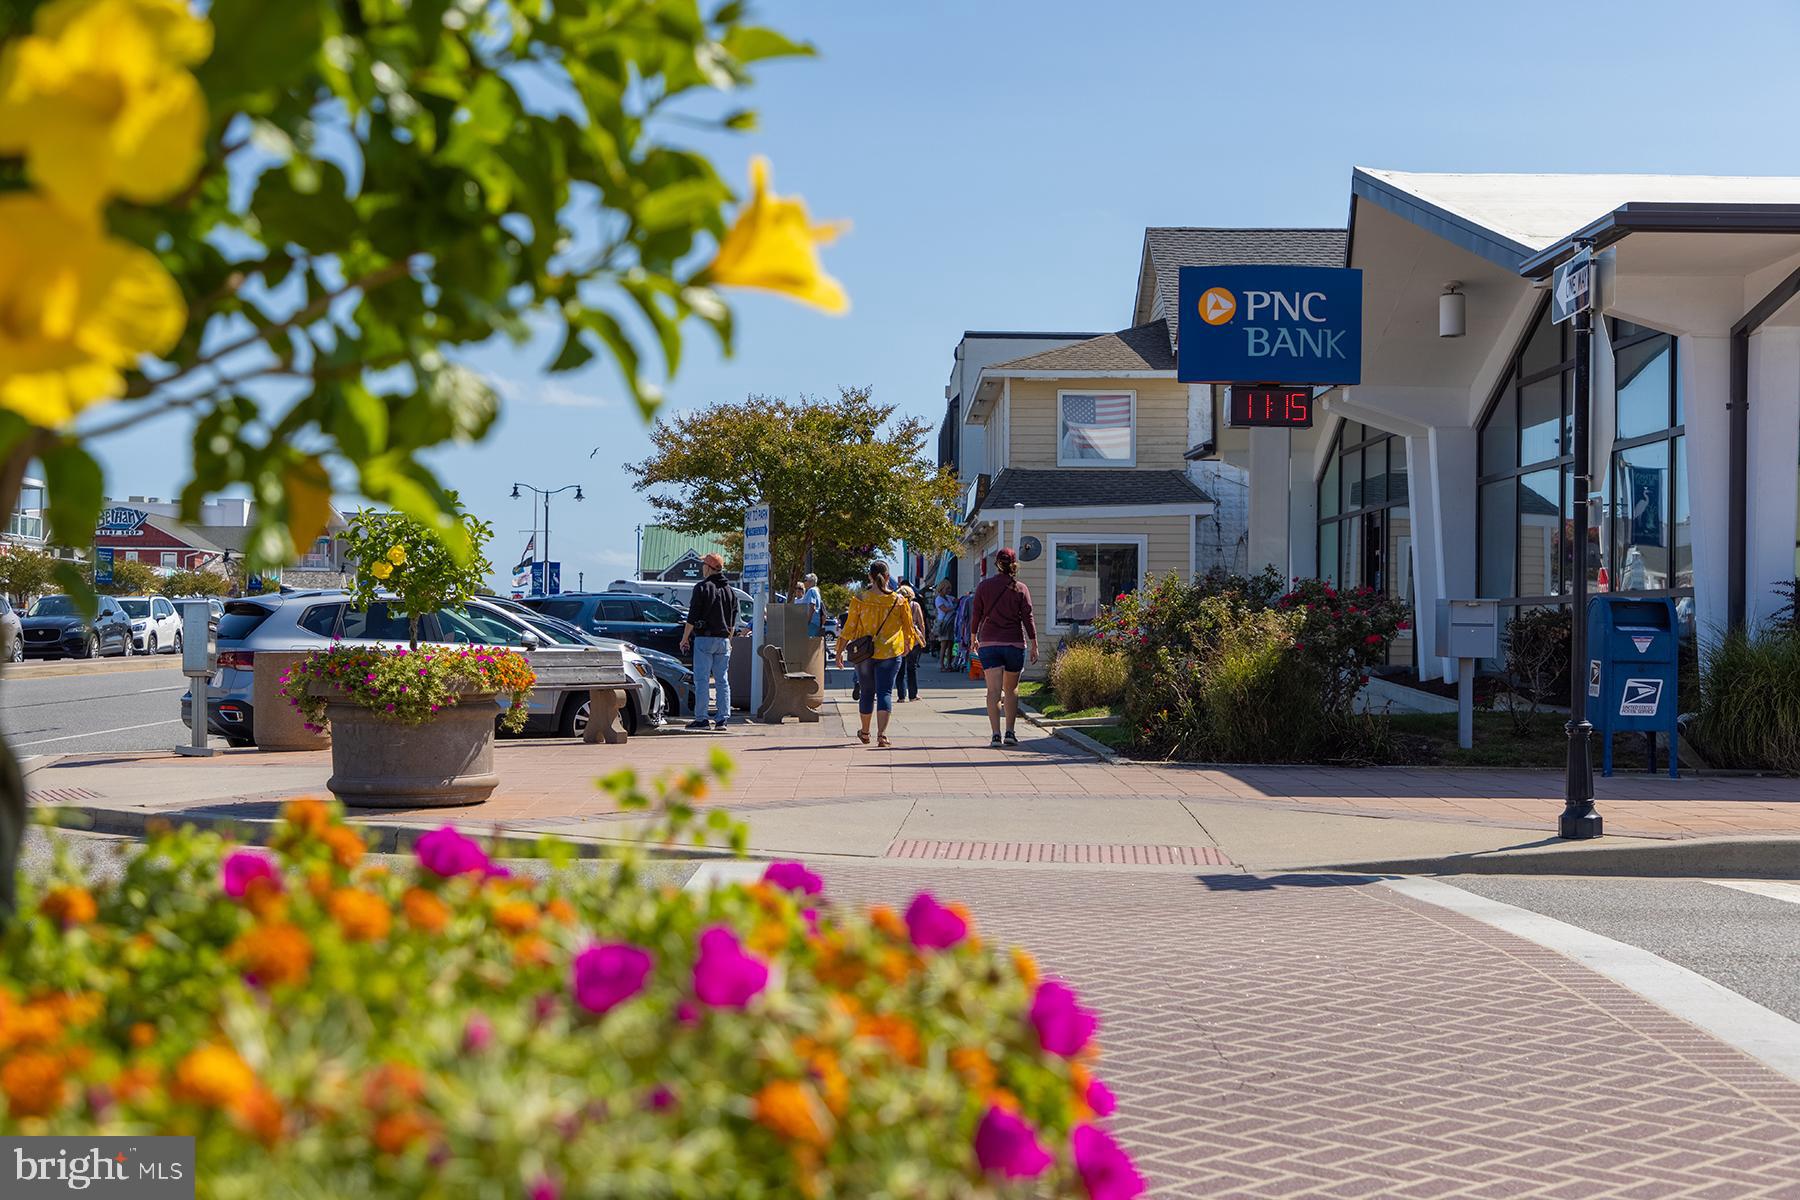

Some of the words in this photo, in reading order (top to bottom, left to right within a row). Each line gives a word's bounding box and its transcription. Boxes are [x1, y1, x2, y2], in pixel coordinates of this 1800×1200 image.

[1242, 291, 1327, 322] PNC
[1242, 327, 1346, 359] BANK
[1247, 393, 1307, 421] 11:15
